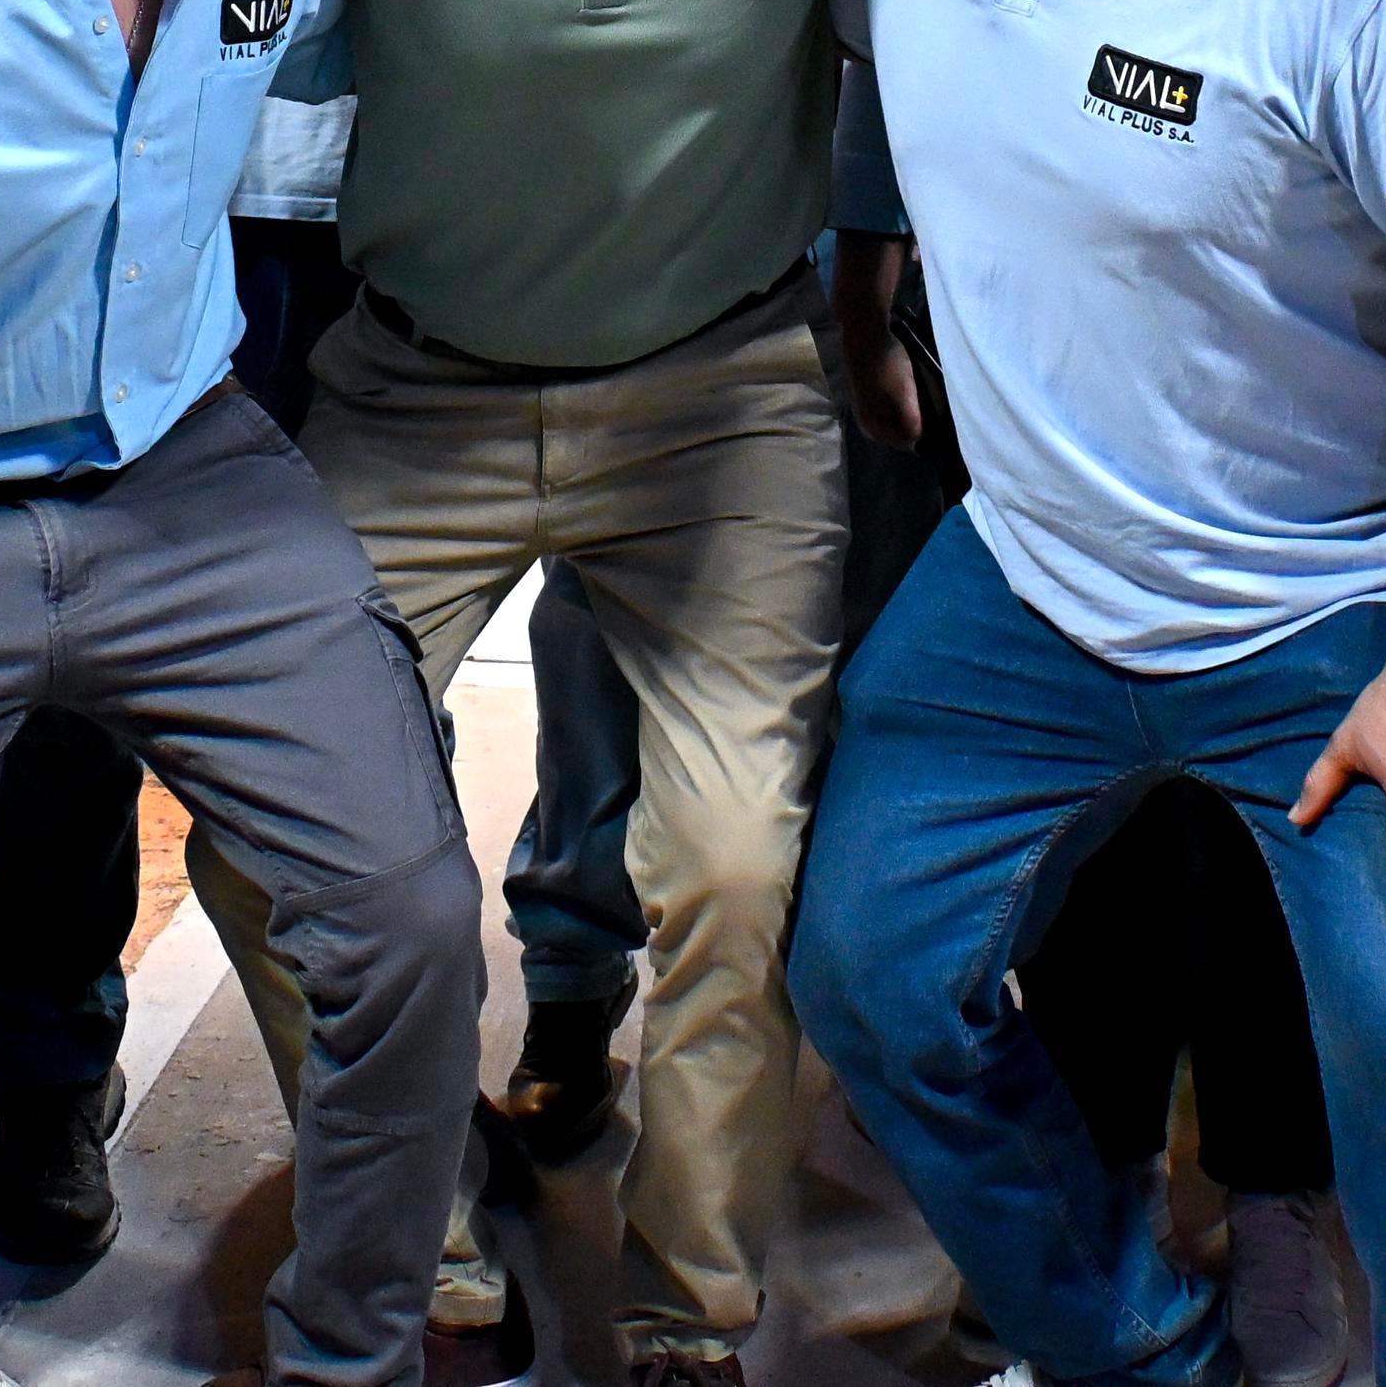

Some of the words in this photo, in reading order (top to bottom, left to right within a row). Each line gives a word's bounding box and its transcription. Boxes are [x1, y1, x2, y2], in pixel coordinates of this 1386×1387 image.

[219, 43, 256, 61] VIAL
[1083, 94, 1116, 122] VIAL
[1120, 110, 1164, 136] PLUS
[1168, 127, 1195, 144] S.A.
